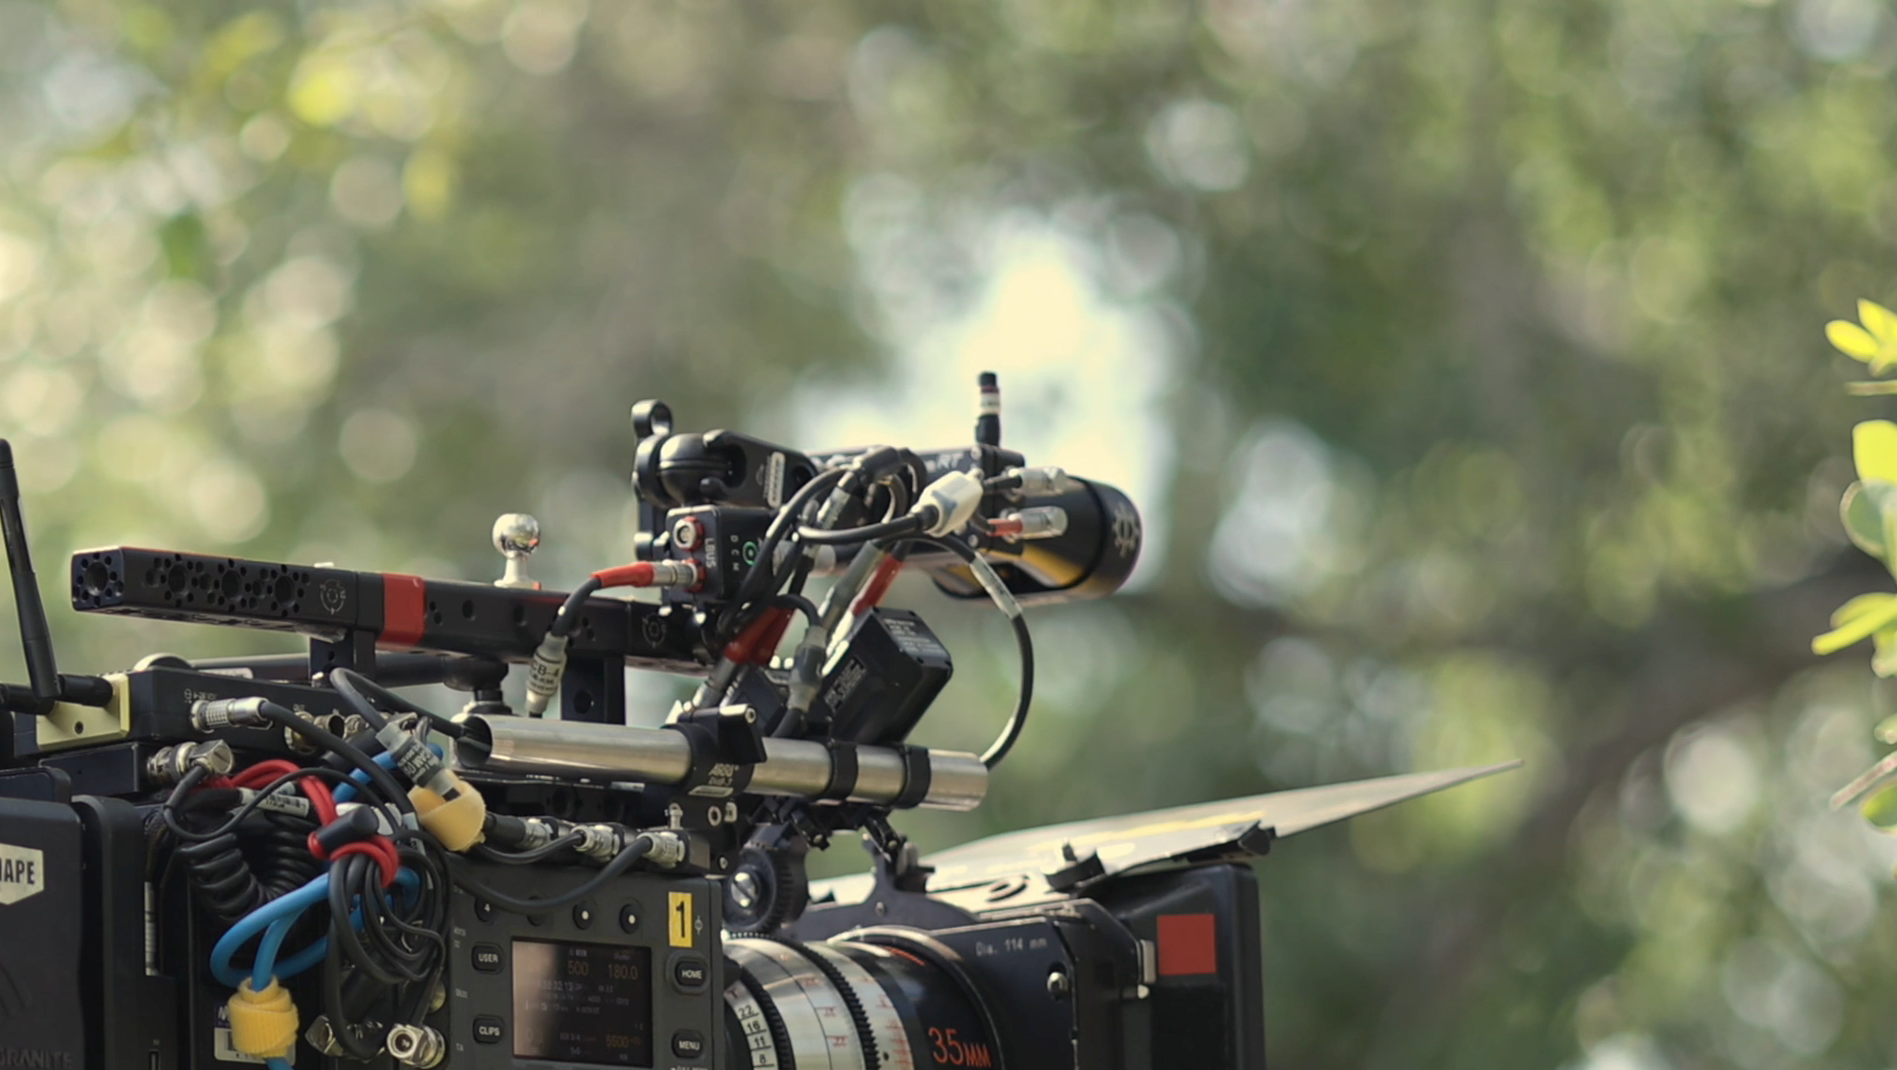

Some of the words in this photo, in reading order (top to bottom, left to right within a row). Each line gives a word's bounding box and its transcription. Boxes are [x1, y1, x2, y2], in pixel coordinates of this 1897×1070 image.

[676, 900, 686, 939] 1
[478, 953, 498, 963] USER
[681, 969, 702, 979] HOME
[738, 1005, 753, 1019] 22
[478, 1026, 500, 1037] CLIPS
[746, 1022, 760, 1035] 16
[678, 1040, 700, 1050] MENU
[754, 1036, 766, 1048] 11
